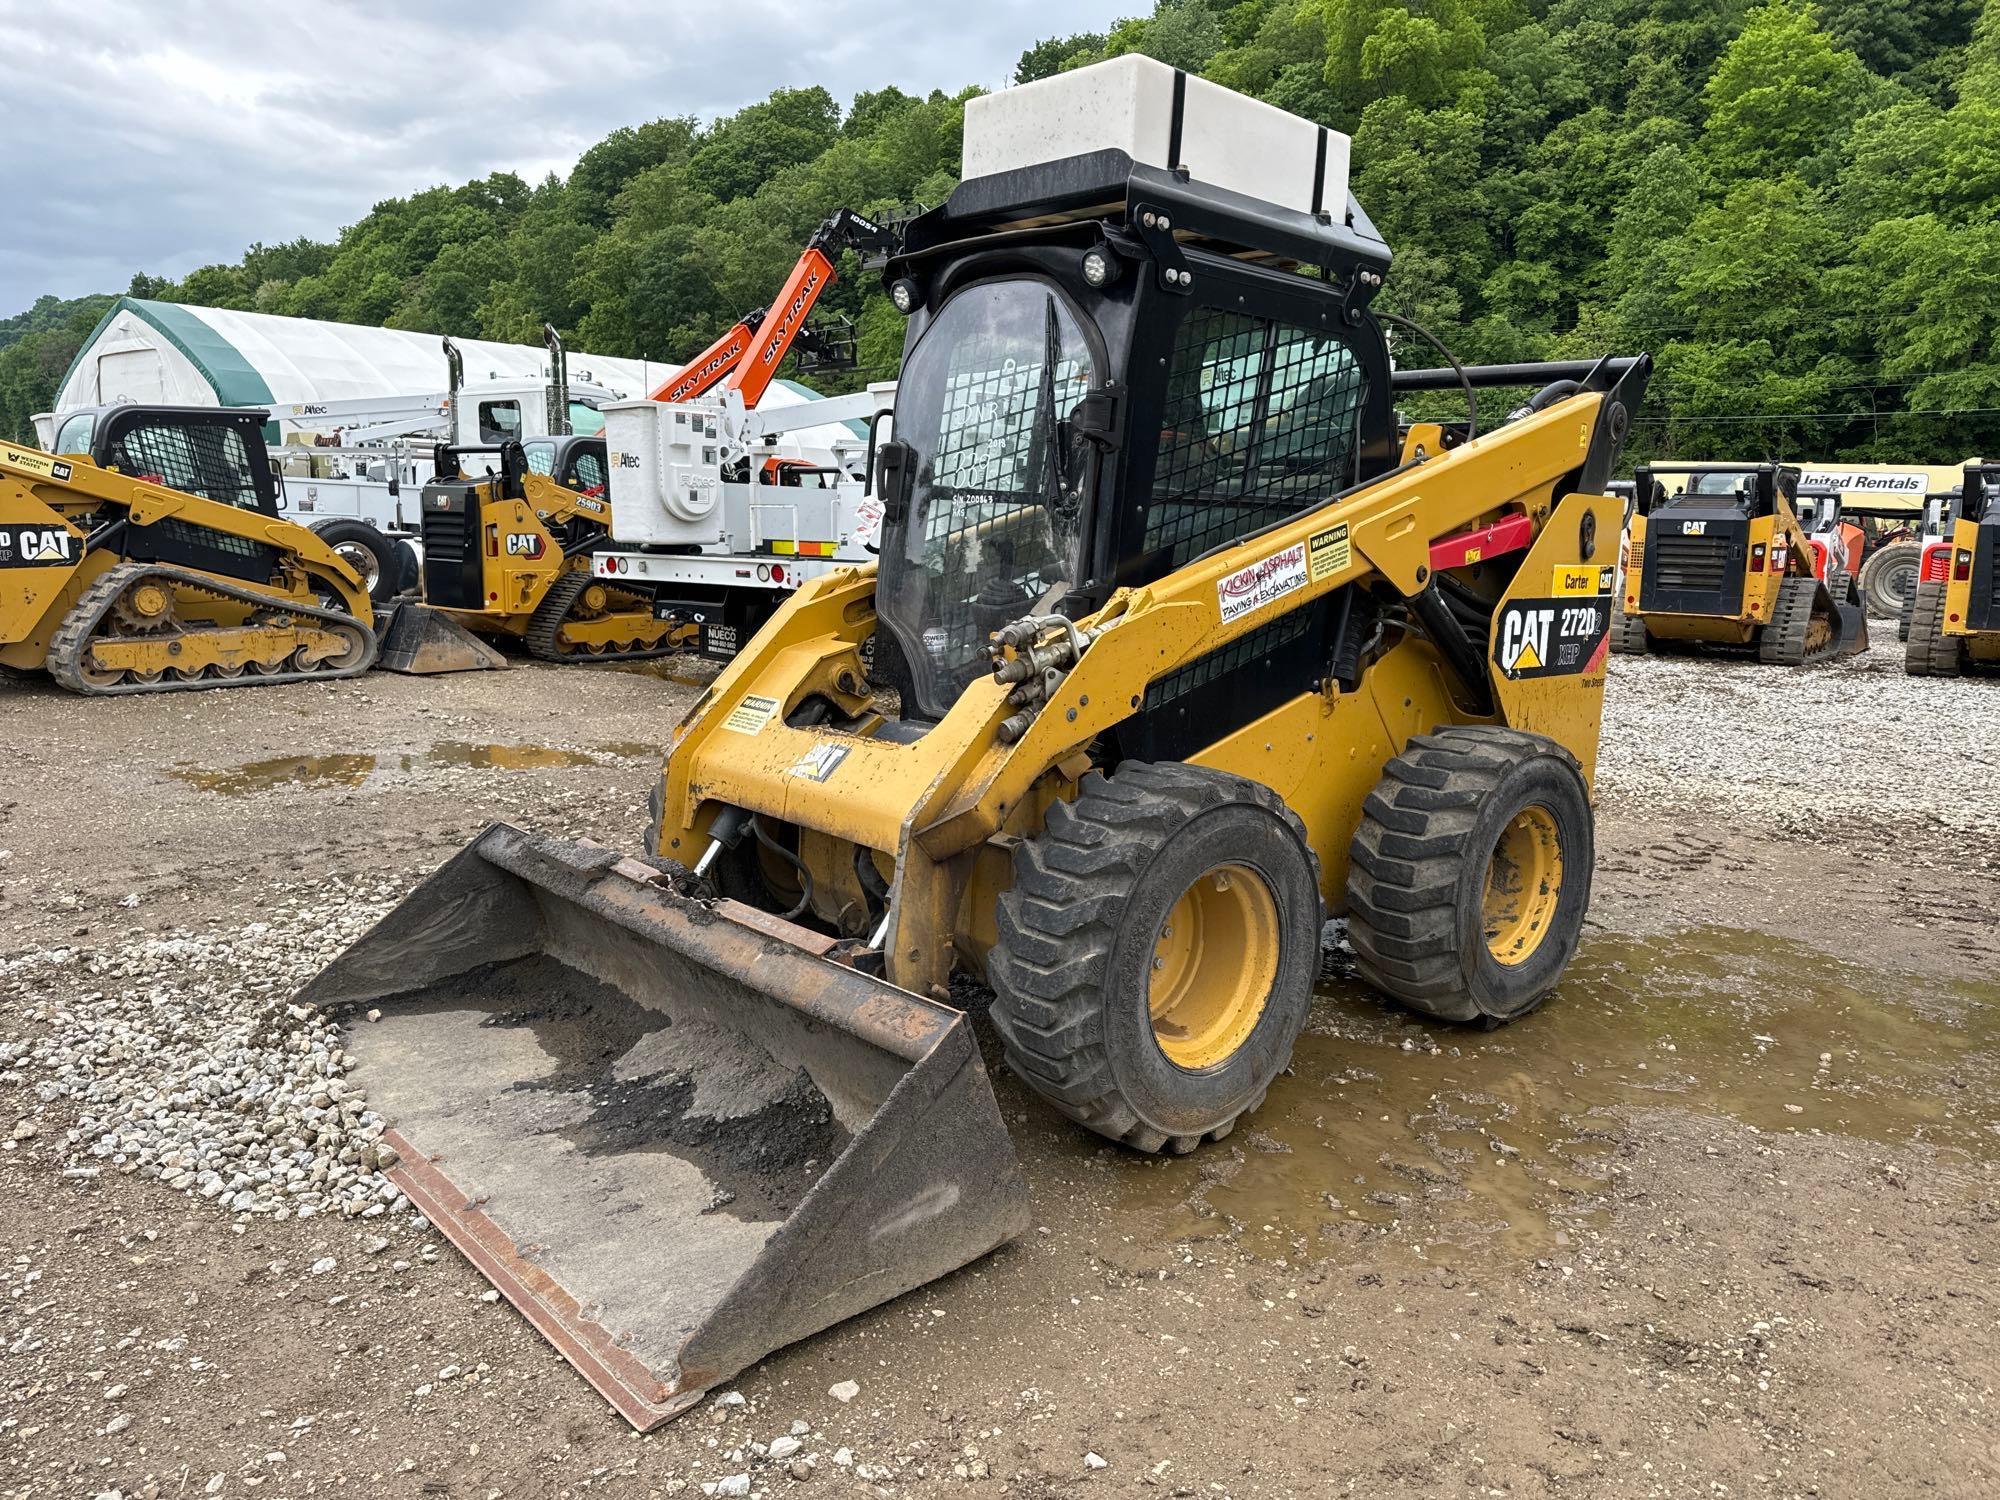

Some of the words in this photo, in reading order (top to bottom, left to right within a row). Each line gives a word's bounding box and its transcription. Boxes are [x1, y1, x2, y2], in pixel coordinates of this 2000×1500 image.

[850, 214, 878, 234] 10054
[764, 268, 820, 365] SKYTRAK
[670, 339, 742, 402] SKYTRAK
[304, 405, 328, 415] Altec
[19, 460, 41, 470] STATES
[20, 455, 49, 468] WESTERN
[620, 452, 640, 468] Altec
[53, 465, 70, 478] CAT
[1854, 476, 1920, 490] Rentals
[437, 495, 448, 506] CAT
[576, 496, 602, 512] 259D3
[1683, 521, 1707, 535] CAT
[20, 531, 71, 560] CAT
[507, 534, 536, 554] CAT
[1312, 528, 1347, 549] WARNING
[1220, 568, 1256, 602] KICKIN
[1261, 546, 1304, 578] ASPHALT
[1565, 574, 1588, 590] Carter
[1600, 573, 1612, 588] CAT
[1222, 597, 1252, 618] PAVING
[1260, 571, 1308, 600] EXCAVATING
[708, 628, 736, 642] NUECO
[1502, 610, 1555, 670] CAT
[1558, 643, 1580, 666] XHP
